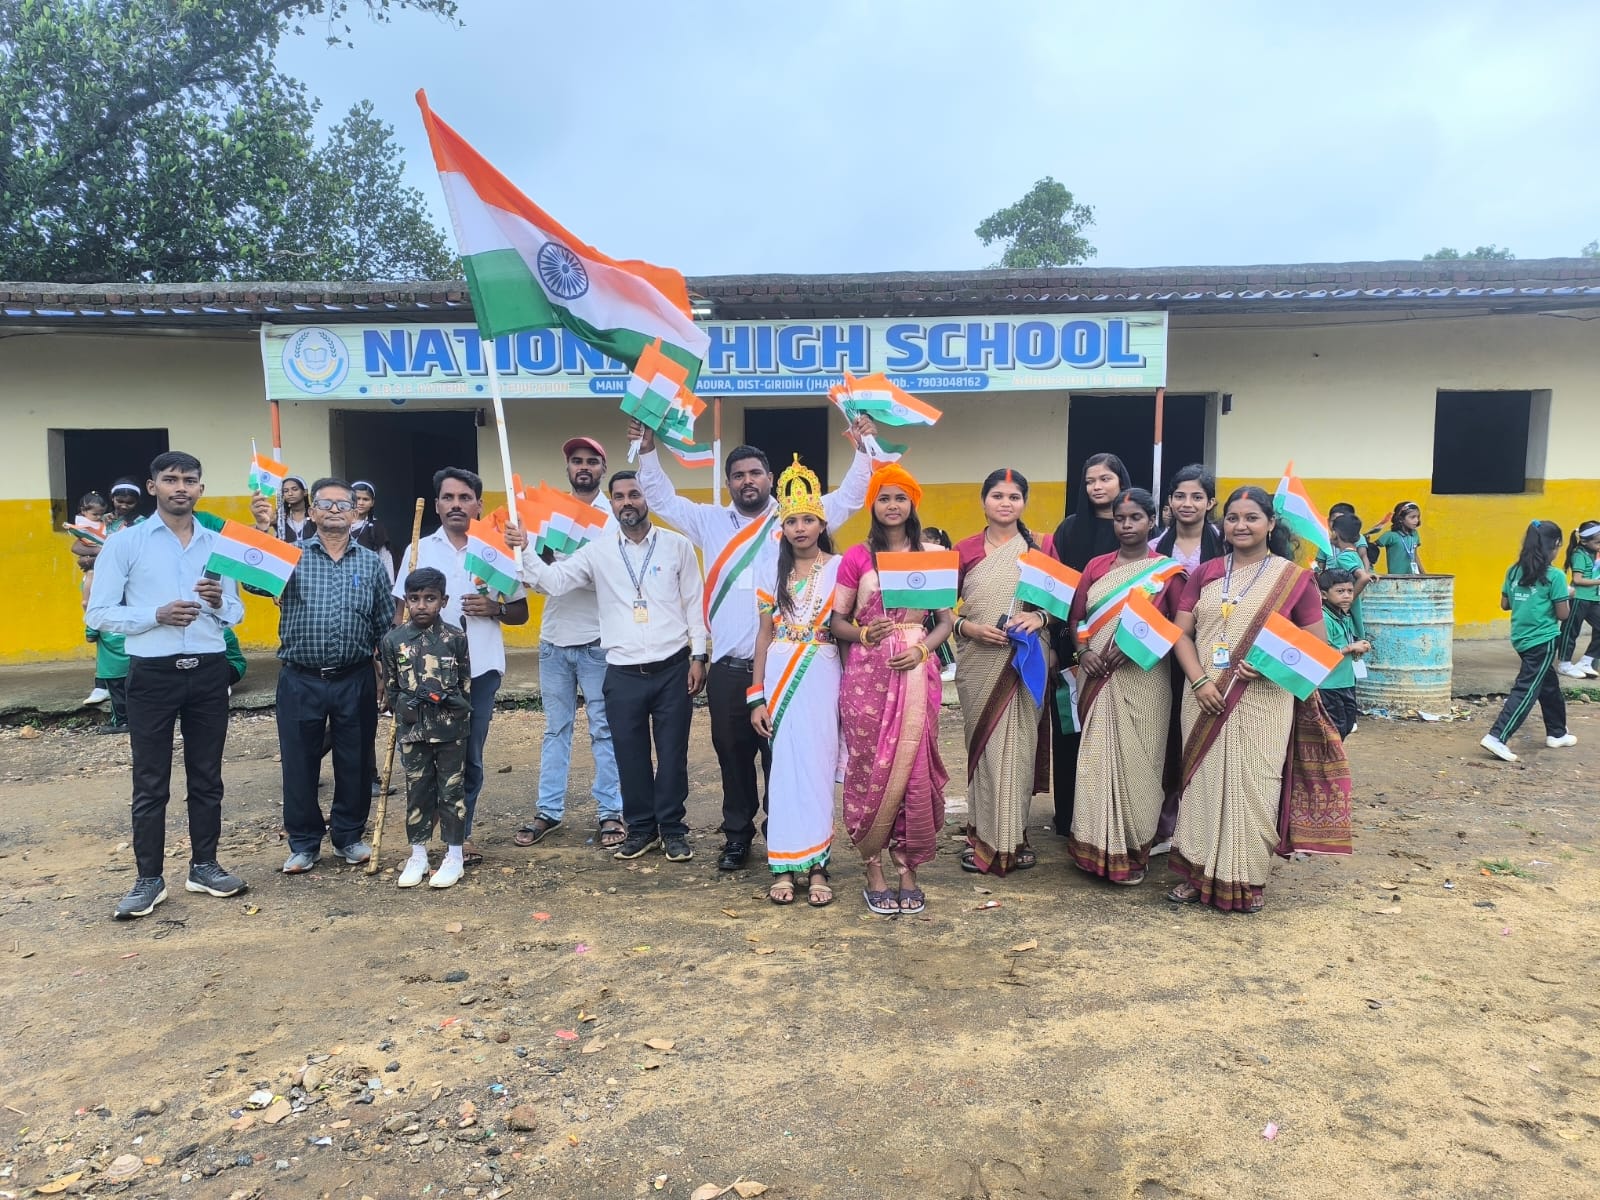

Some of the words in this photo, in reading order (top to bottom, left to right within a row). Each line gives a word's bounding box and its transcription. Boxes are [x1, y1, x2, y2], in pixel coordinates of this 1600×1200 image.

[363, 328, 630, 377] NATION
[708, 323, 870, 375] HIGH
[885, 320, 1146, 373] SCHOOL
[595, 380, 624, 391] MAIN
[737, 379, 803, 390] DIST-GIRIDIH
[917, 377, 981, 388] 7903048162
